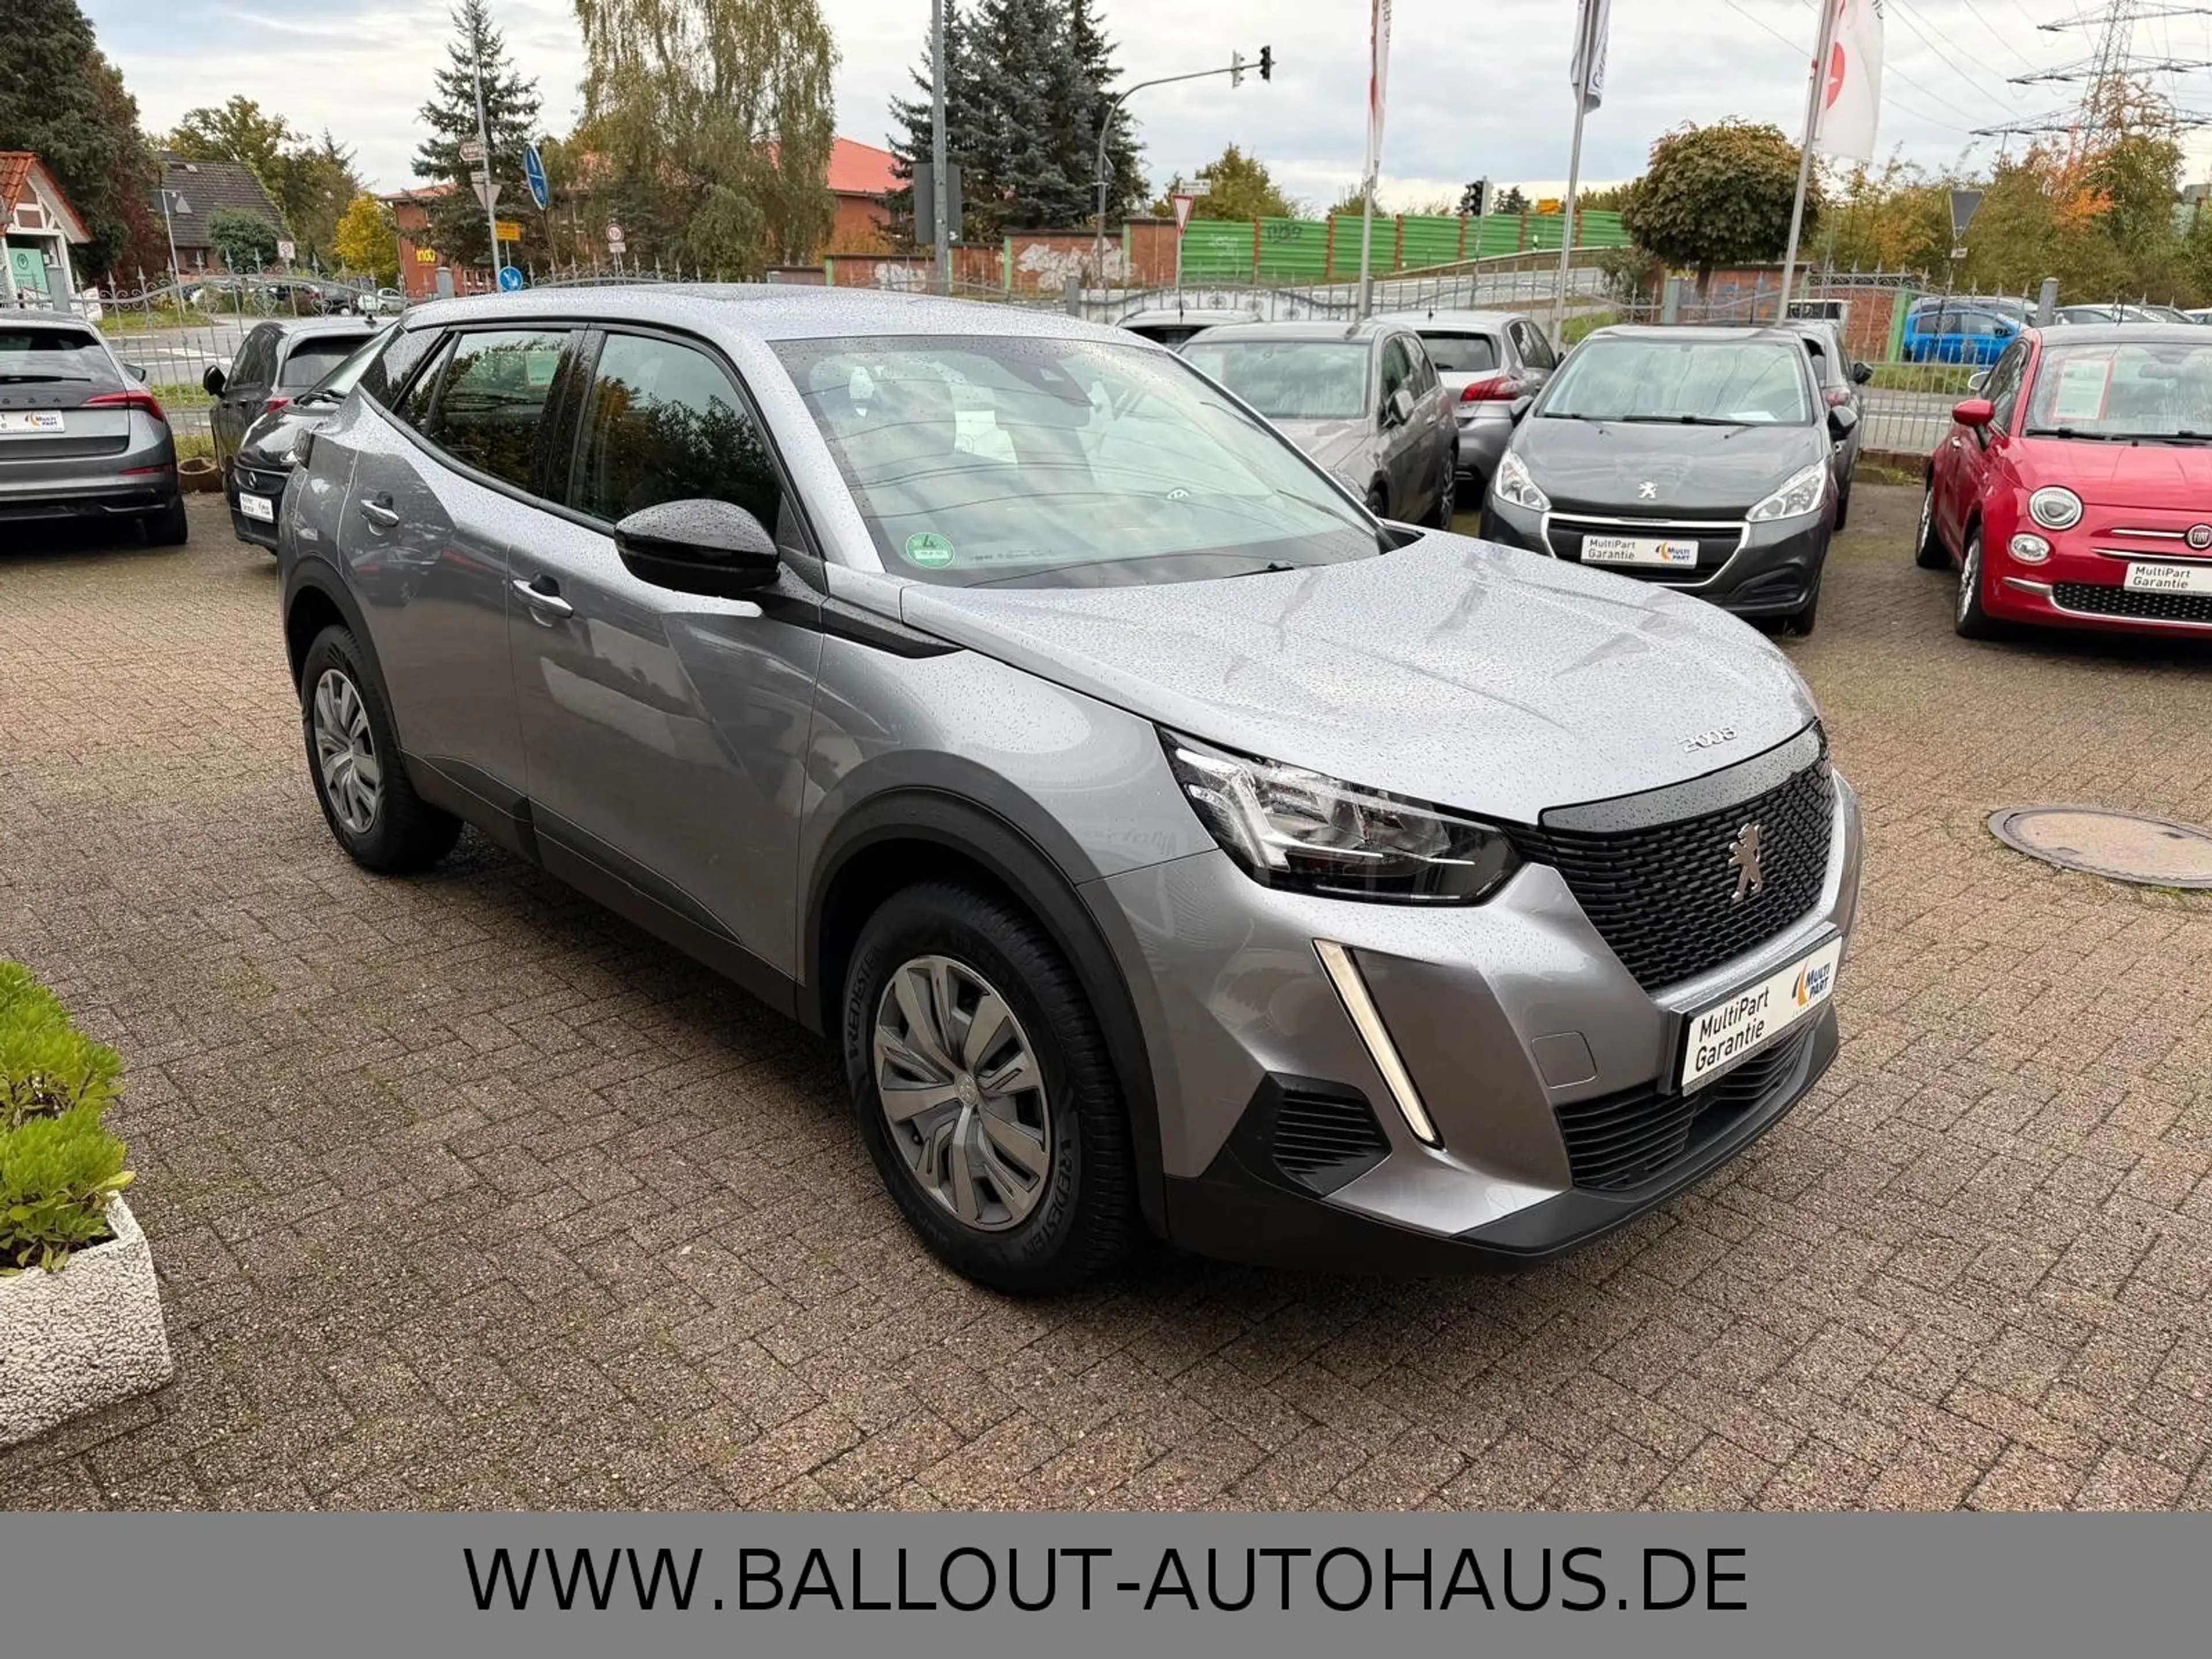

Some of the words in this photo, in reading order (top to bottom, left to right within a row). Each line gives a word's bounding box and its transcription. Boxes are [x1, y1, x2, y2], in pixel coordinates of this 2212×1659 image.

[2194, 532, 2209, 542] FIAT
[1589, 539, 1636, 550] MultiPart
[1588, 548, 1635, 560] Garantie
[2135, 566, 2191, 578] MultiPart
[2133, 576, 2188, 588] Garantie
[1679, 726, 1737, 753] 2008
[1809, 976, 1829, 999] PART
[1699, 986, 1769, 1043] MultiPart
[1695, 1019, 1764, 1073] Garantie
